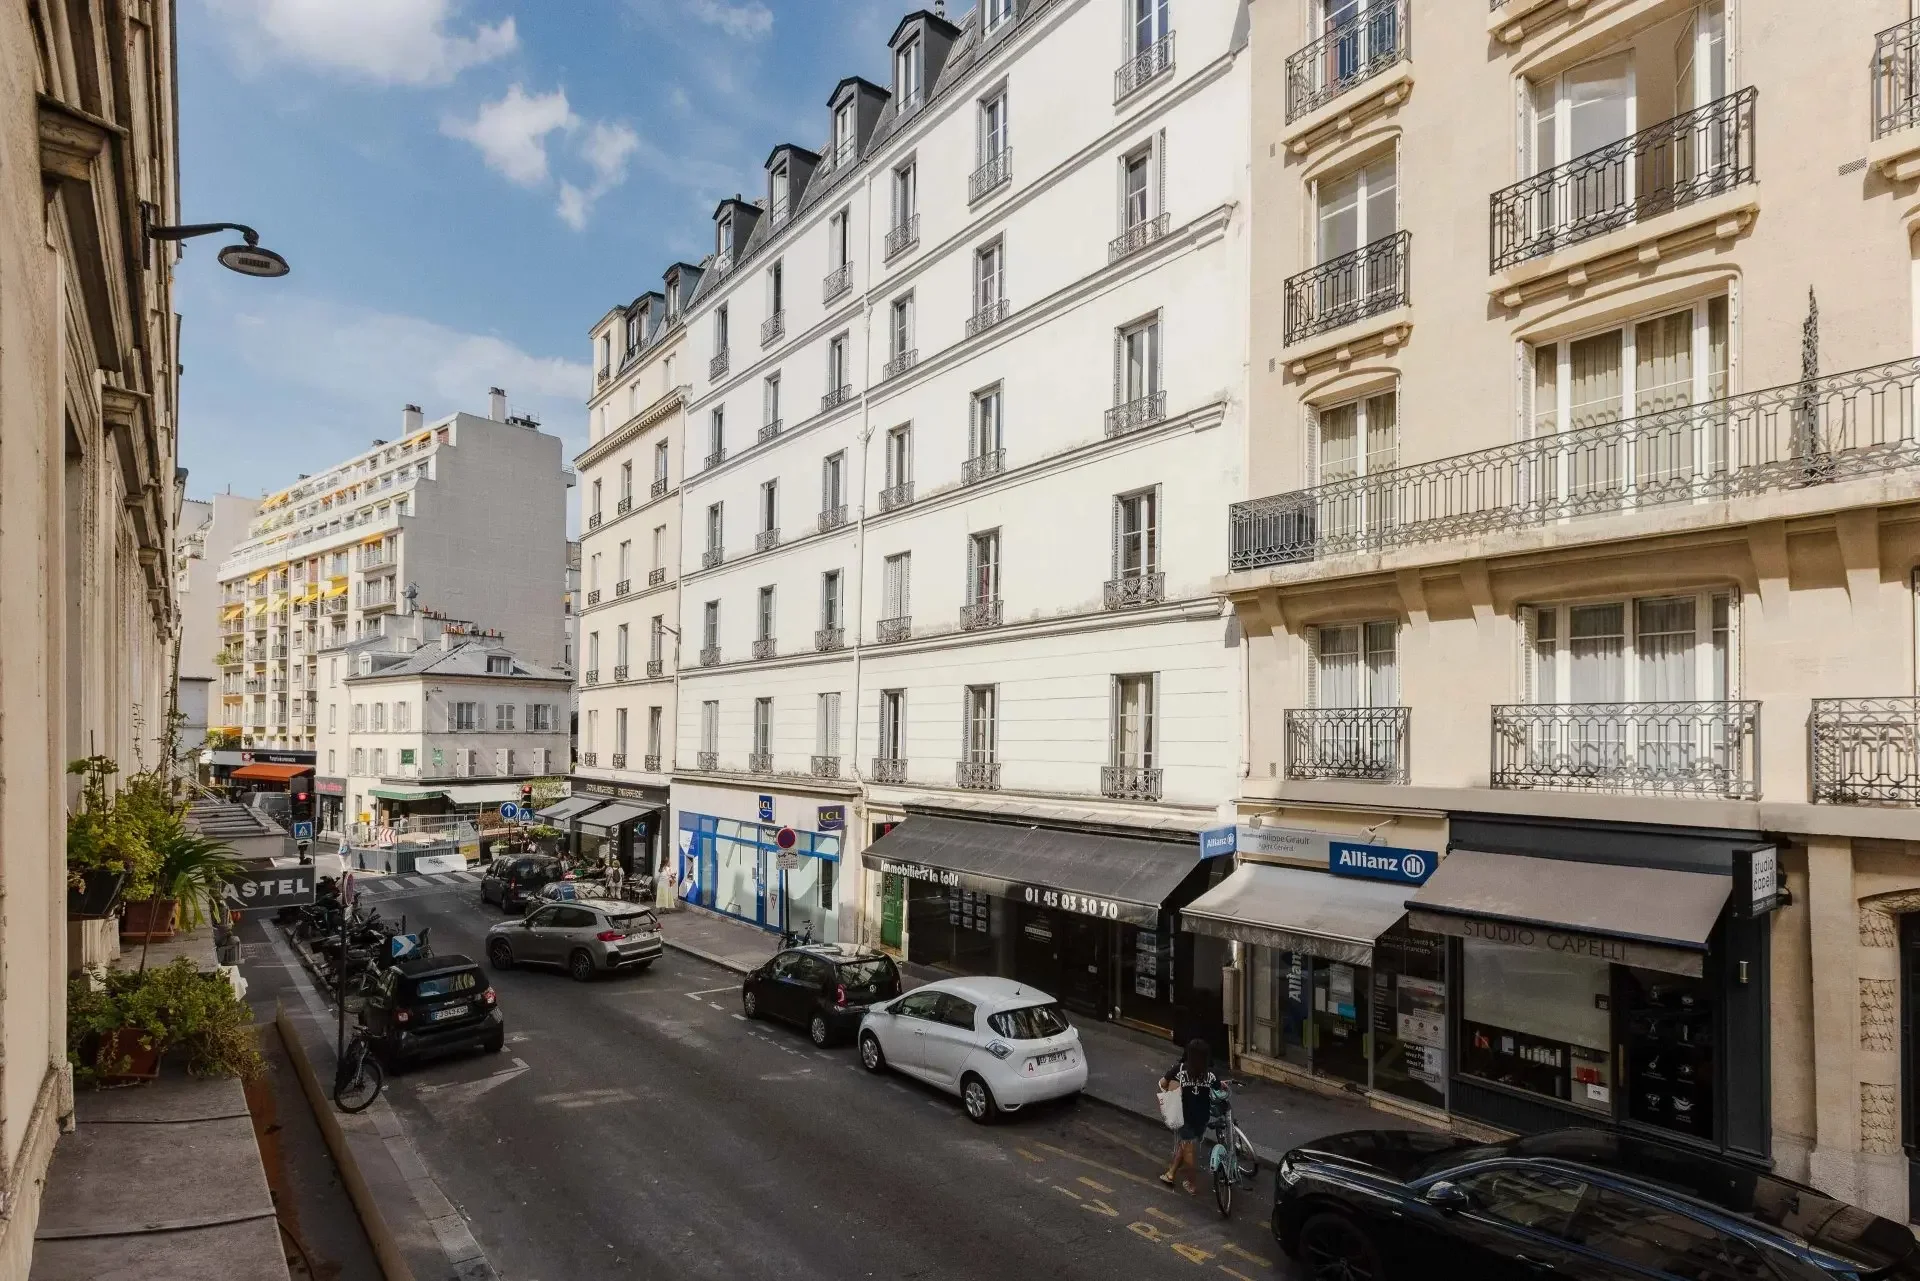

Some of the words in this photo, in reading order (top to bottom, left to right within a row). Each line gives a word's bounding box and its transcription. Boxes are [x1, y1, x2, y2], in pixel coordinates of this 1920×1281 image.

[759, 800, 772, 810] LCL
[820, 811, 842, 820] LCL
[1206, 836, 1228, 849] Allianz
[1339, 849, 1398, 872] Allianz
[1754, 856, 1774, 875] studio
[929, 868, 938, 883] la
[1753, 873, 1775, 892] capelli
[221, 878, 310, 900] ASTEL
[1025, 886, 1039, 904] 01
[1043, 890, 1058, 907] 45
[1061, 893, 1077, 911] 03
[1100, 900, 1118, 919] 70
[1463, 920, 1535, 946] STUDIO
[1546, 931, 1627, 961] CAPELLI
[1028, 1062, 1034, 1072] A
